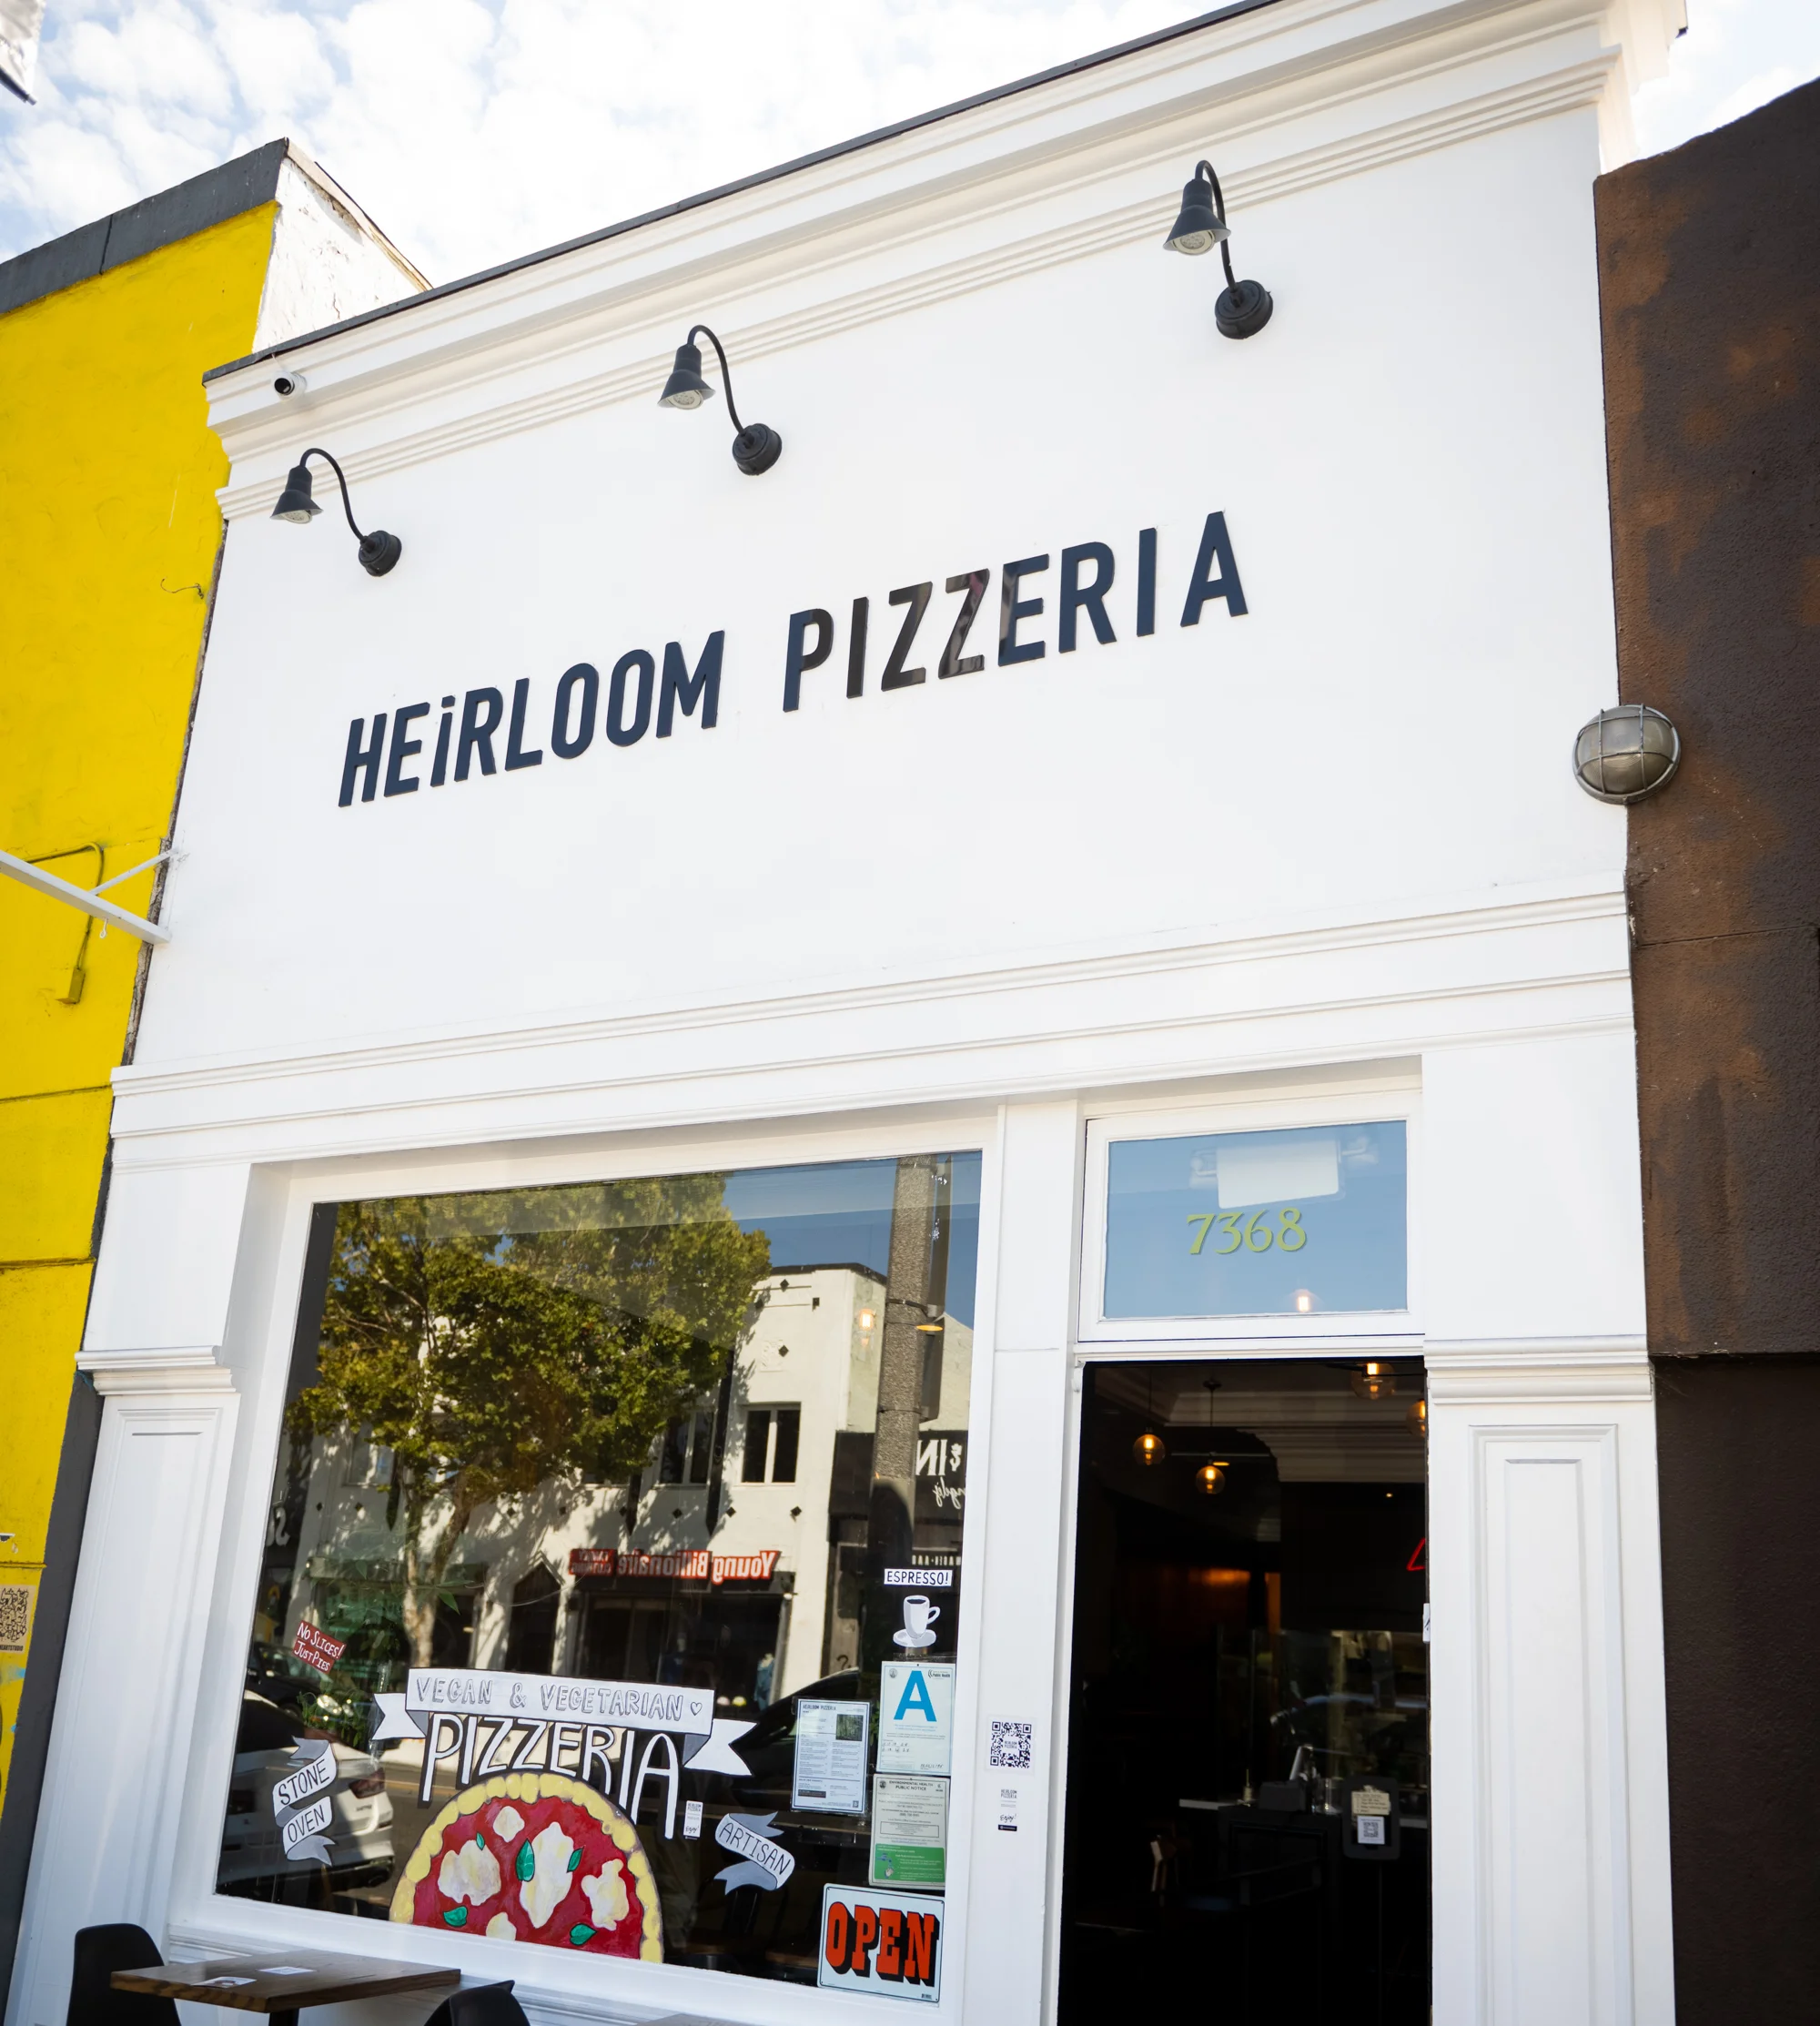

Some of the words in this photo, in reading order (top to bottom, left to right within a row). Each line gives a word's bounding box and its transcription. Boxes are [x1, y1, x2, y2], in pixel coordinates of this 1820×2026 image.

[782, 510, 1249, 714] PIZZERIA
[1186, 1206, 1308, 1255] 7368
[886, 1570, 949, 1585] ESPRESSO!
[294, 1640, 314, 1662] JUST
[311, 1650, 330, 1672] PIES
[310, 1630, 345, 1659] SLICES!
[416, 1677, 493, 1705] VEGAN
[509, 1681, 528, 1709] &
[540, 1683, 684, 1722] VEGETARIAN
[893, 1670, 937, 1723] A
[278, 1758, 330, 1806] STONE
[420, 1712, 681, 1841] PIZZERIA
[288, 1805, 326, 1843] OVEN
[718, 1822, 792, 1876] ARTISAN
[824, 1900, 941, 1988] OPEN
